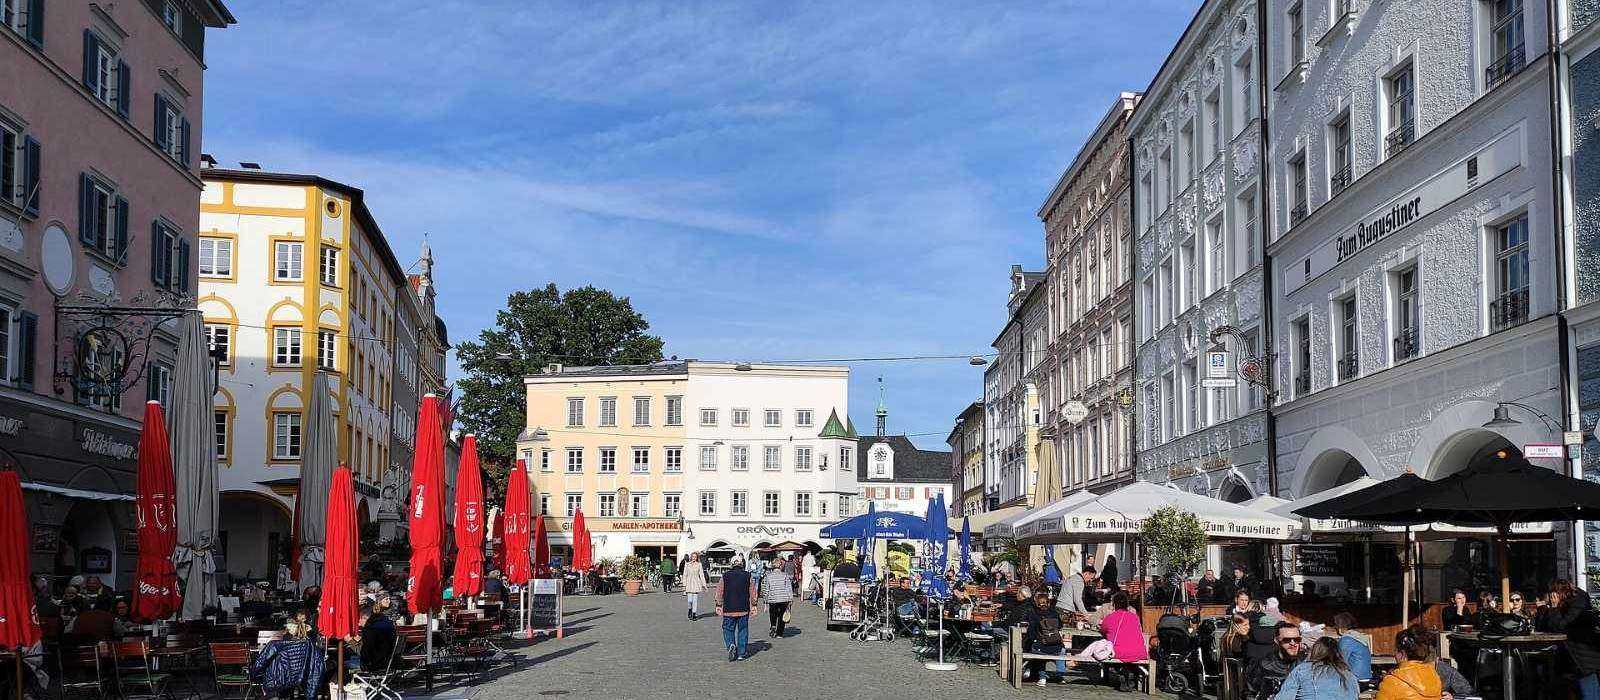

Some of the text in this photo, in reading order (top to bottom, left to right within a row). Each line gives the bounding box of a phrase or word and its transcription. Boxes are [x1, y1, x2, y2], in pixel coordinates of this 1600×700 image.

[1336, 196, 1421, 262] Zum Augustiner
[1085, 518, 1107, 529] Zum
[1203, 521, 1281, 535] Zum Augustiner
